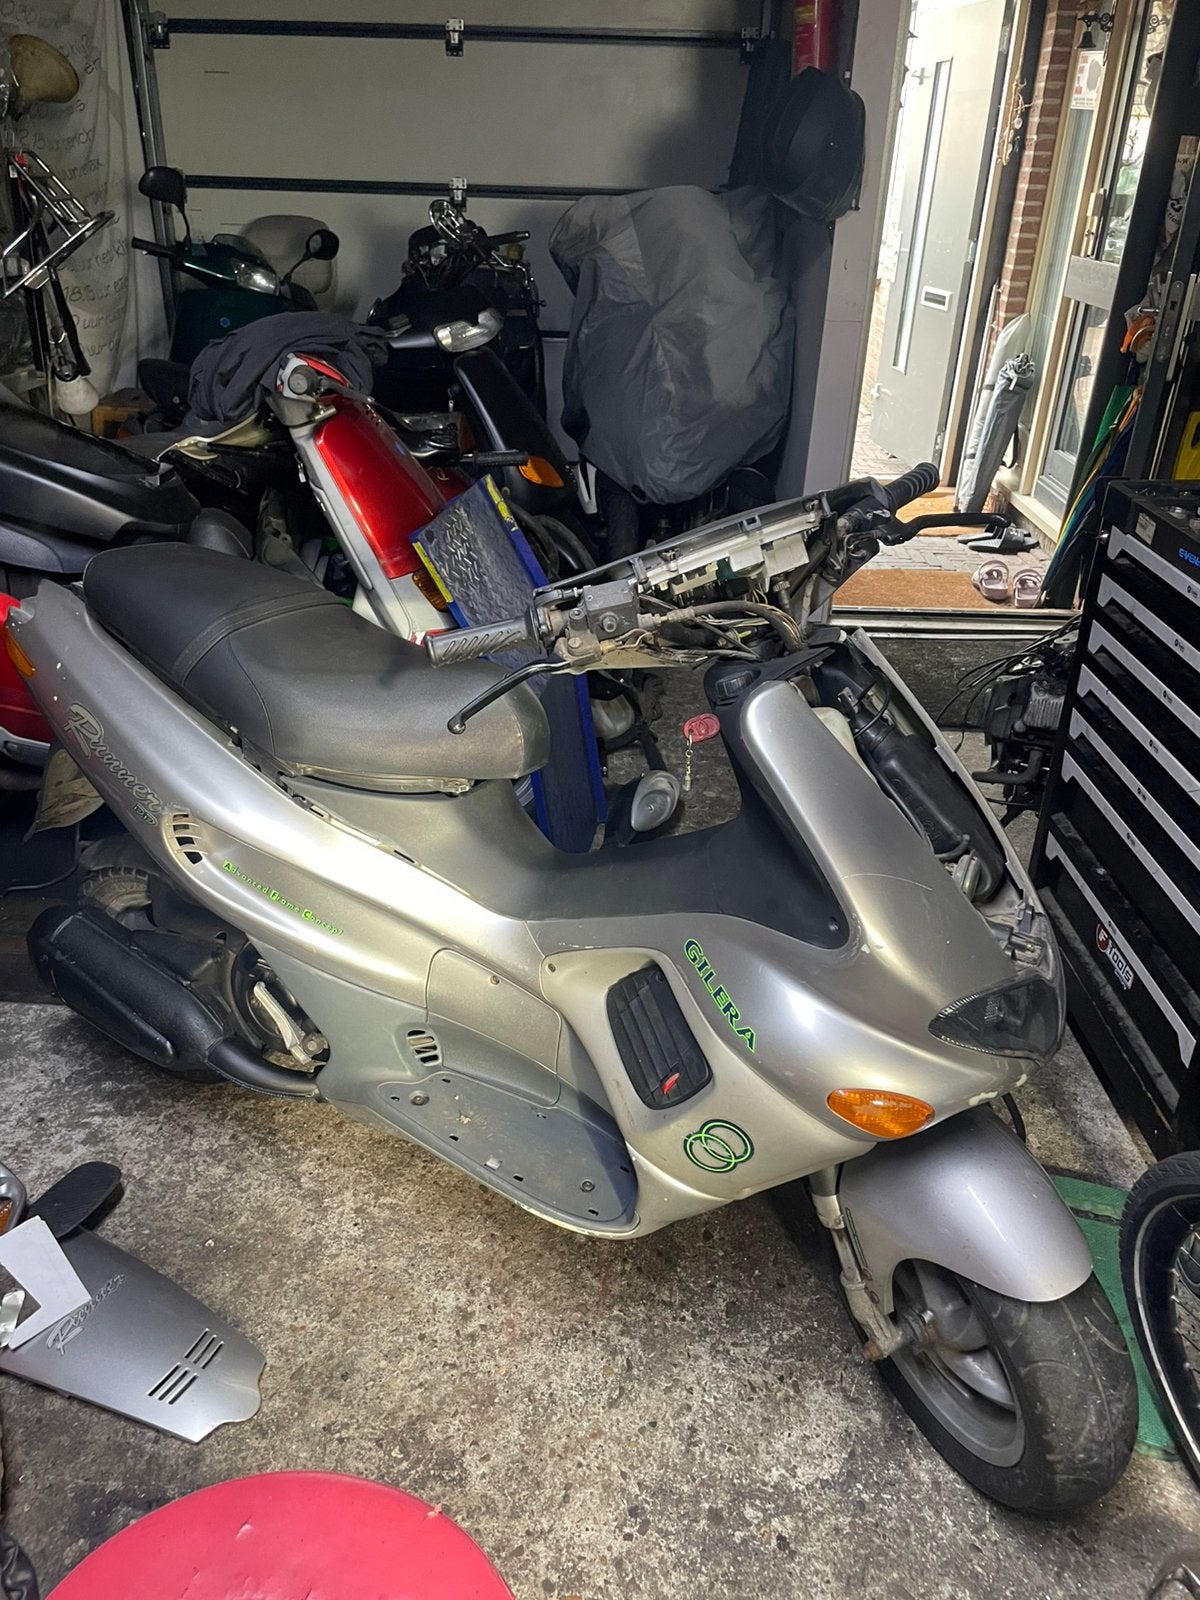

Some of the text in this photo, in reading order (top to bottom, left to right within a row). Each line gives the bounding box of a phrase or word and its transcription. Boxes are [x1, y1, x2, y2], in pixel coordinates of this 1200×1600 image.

[63, 701, 161, 814] Runner
[223, 860, 344, 936] Advanced Frame Concept
[683, 938, 756, 1055] GILERA
[46, 1271, 126, 1356] Runner
